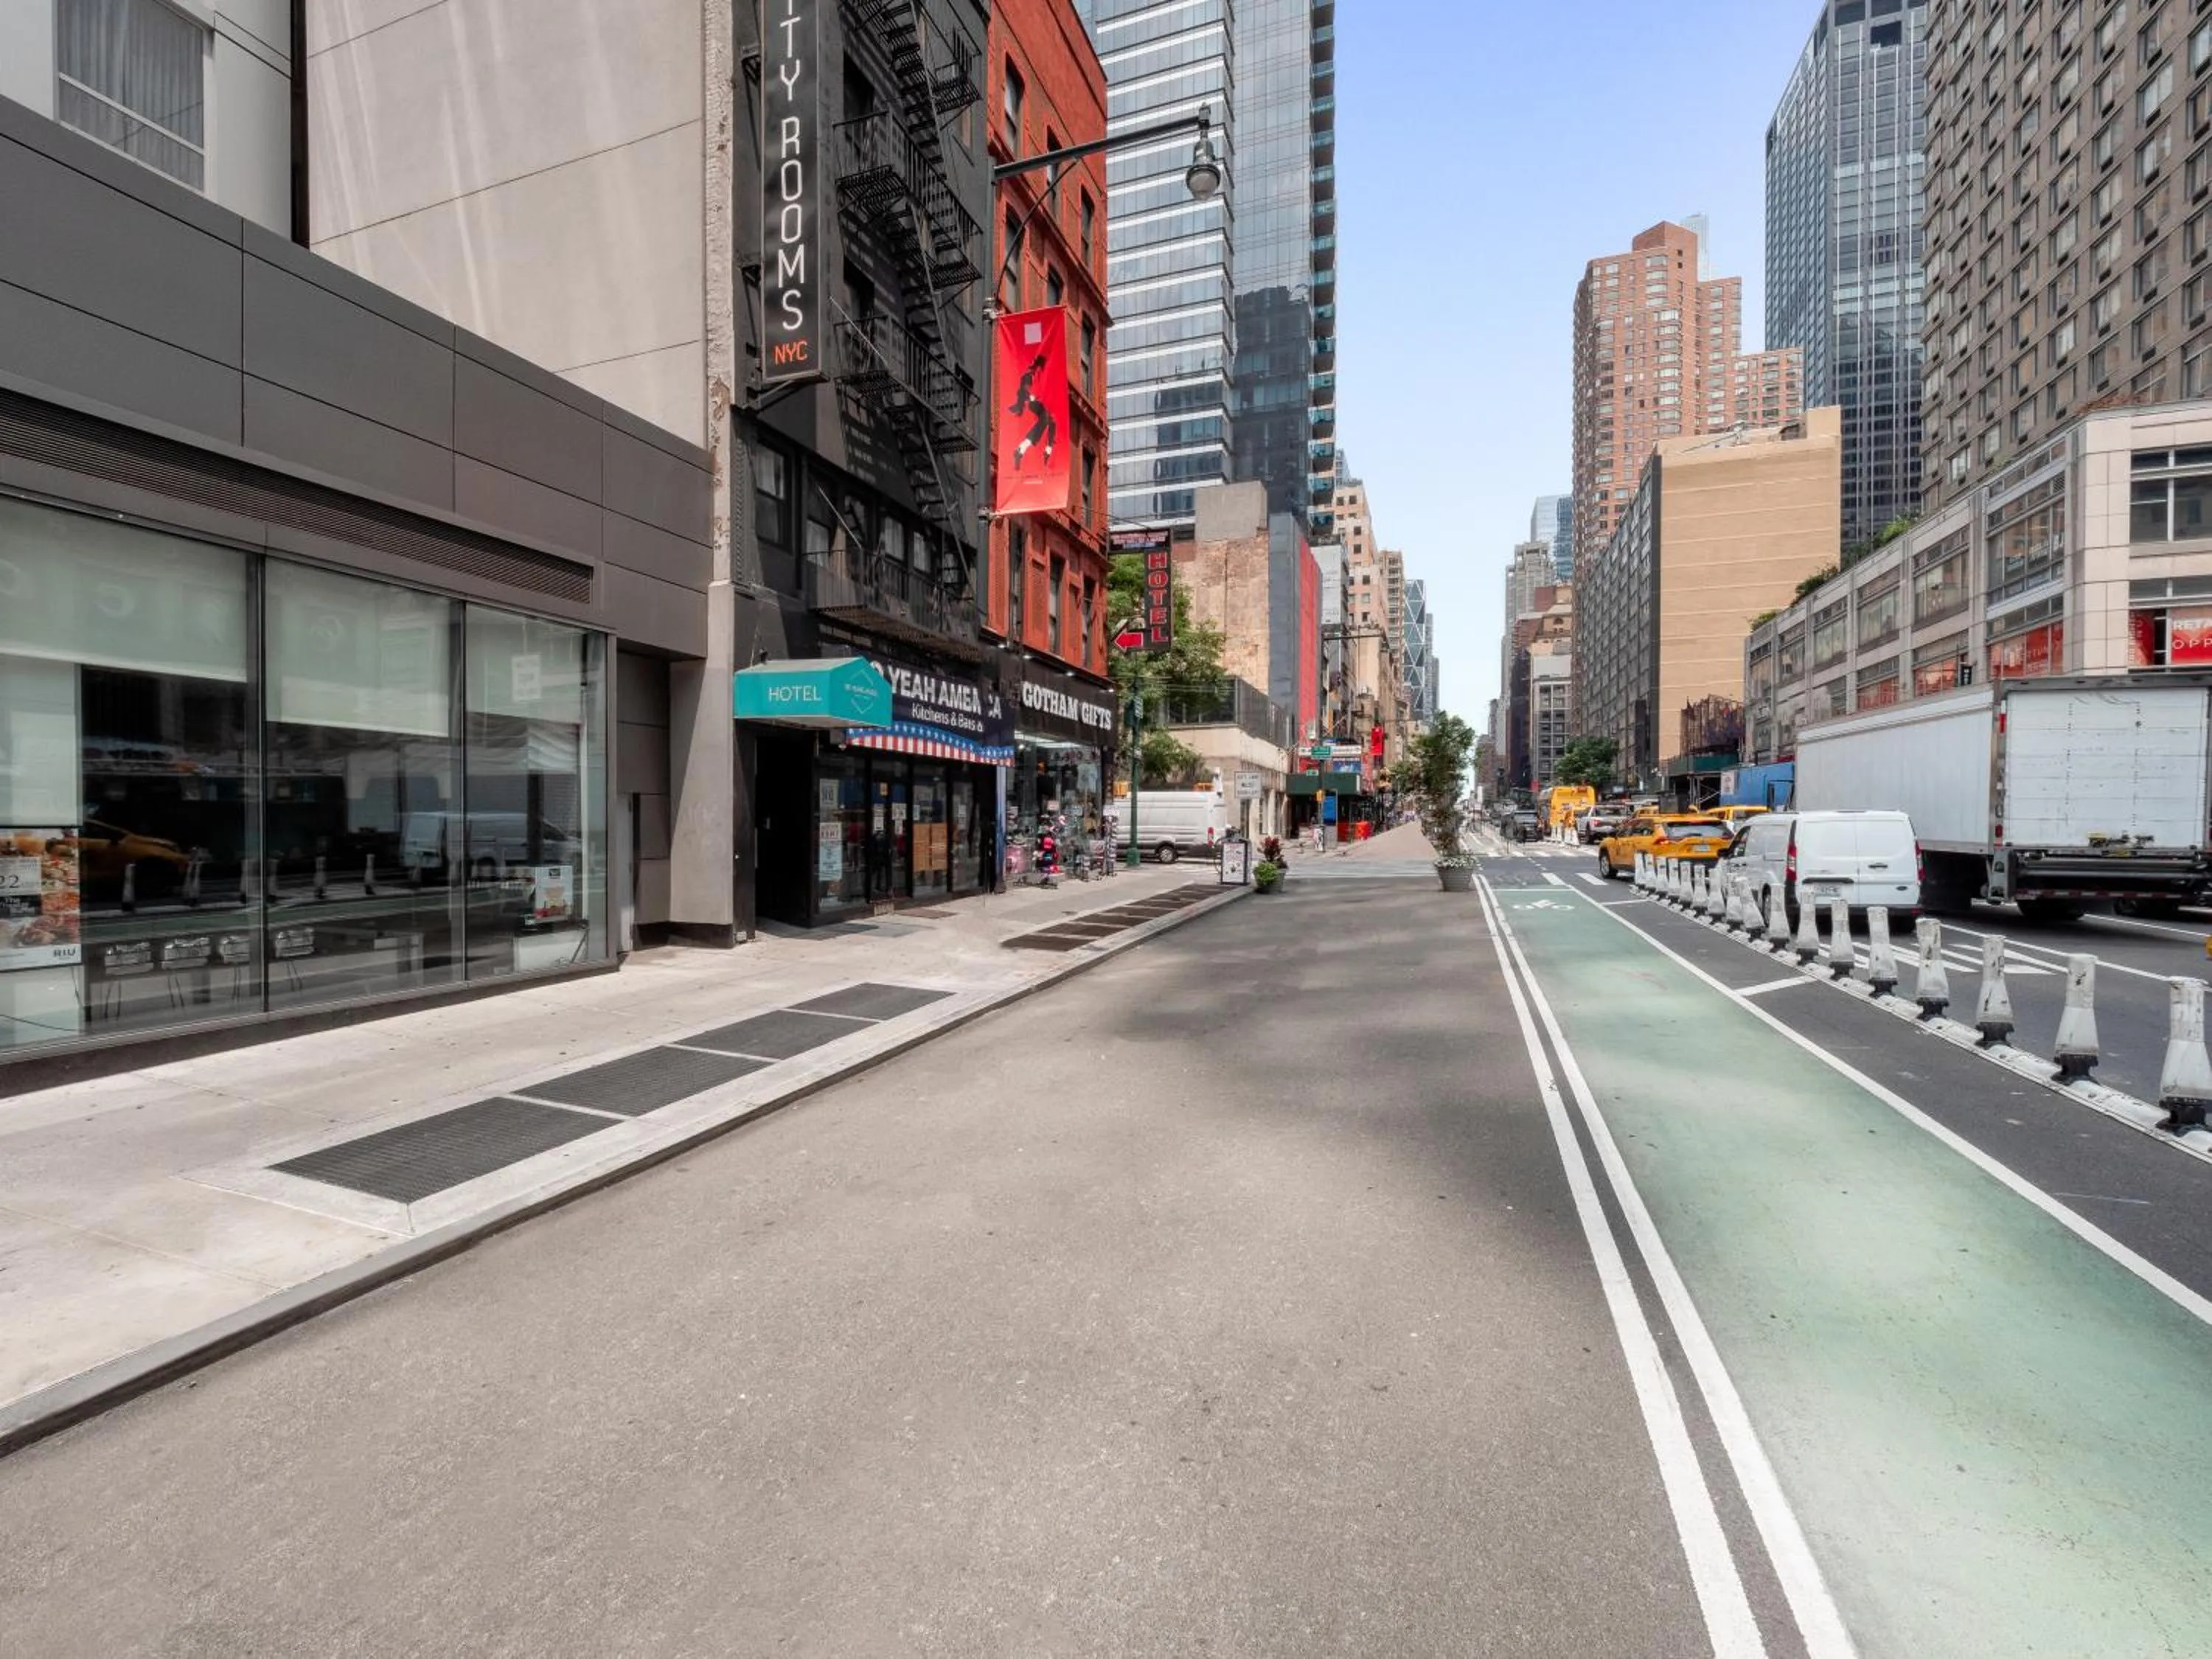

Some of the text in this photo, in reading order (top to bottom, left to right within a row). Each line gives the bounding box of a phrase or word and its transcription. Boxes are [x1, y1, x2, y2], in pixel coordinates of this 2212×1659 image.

[778, 116, 805, 330] ROOMS
[774, 340, 808, 366] NYC
[1147, 552, 1169, 642] HOTEL
[768, 685, 822, 701] HOTEL
[887, 665, 936, 703] YEAH
[1022, 681, 1112, 731] GOTHAM GIFTS
[53, 948, 76, 957] RIU
